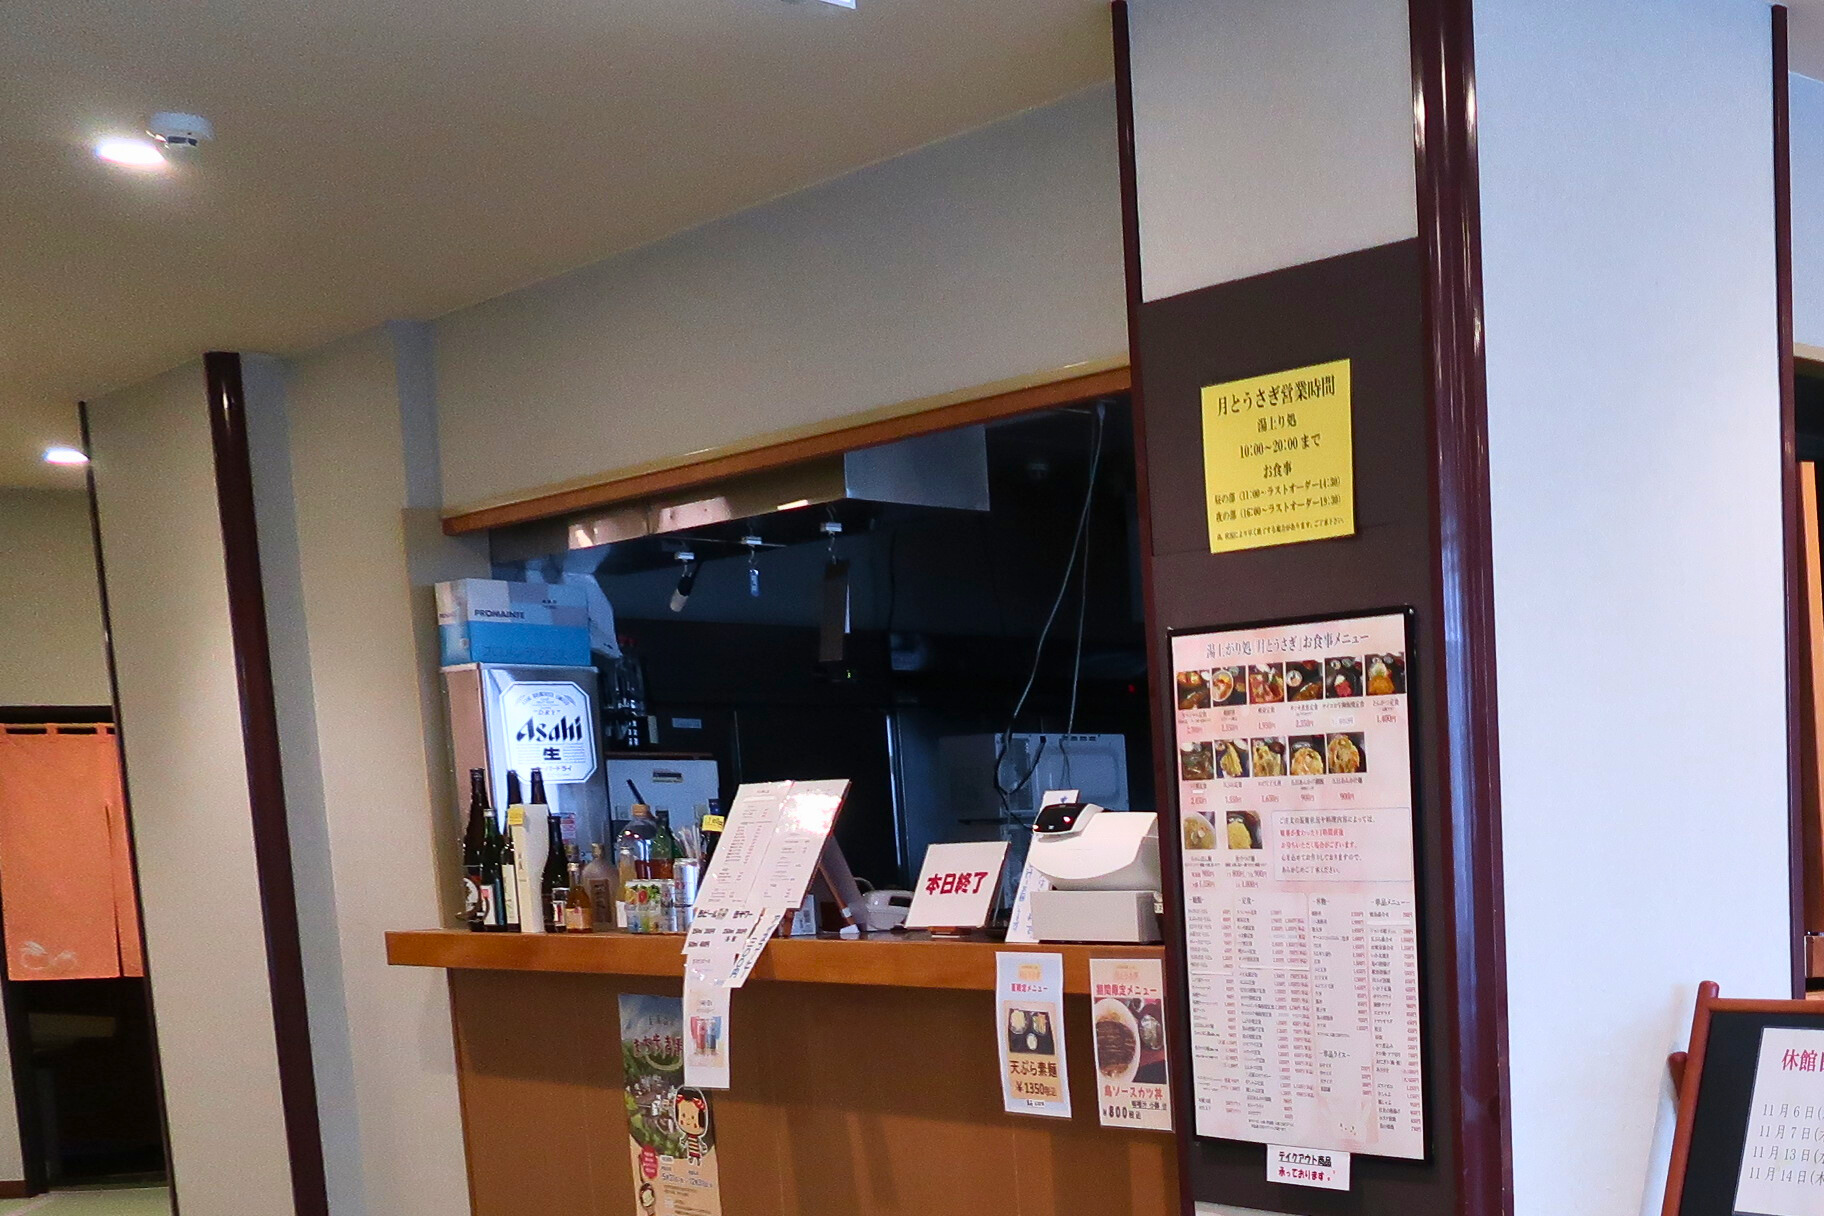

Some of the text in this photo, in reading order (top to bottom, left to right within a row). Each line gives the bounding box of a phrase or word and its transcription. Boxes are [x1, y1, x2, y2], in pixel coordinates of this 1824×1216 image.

[1218, 374, 1335, 416] 月とうさぎ営業時間
[1257, 413, 1297, 433] 湯上り処
[1301, 433, 1321, 449] まで
[1263, 461, 1292, 479] お食事
[1216, 510, 1237, 522] 夜の部
[516, 716, 582, 742] Asahi
[543, 747, 561, 760] 生
[926, 872, 988, 895] 本日終了
[1096, 984, 1157, 996] 期間限定メニュー
[1009, 1060, 1057, 1077] 天ぷら素麺
[1279, 1151, 1331, 1167] テイクアウト商品
[1279, 1166, 1330, 1181] 承っております。
